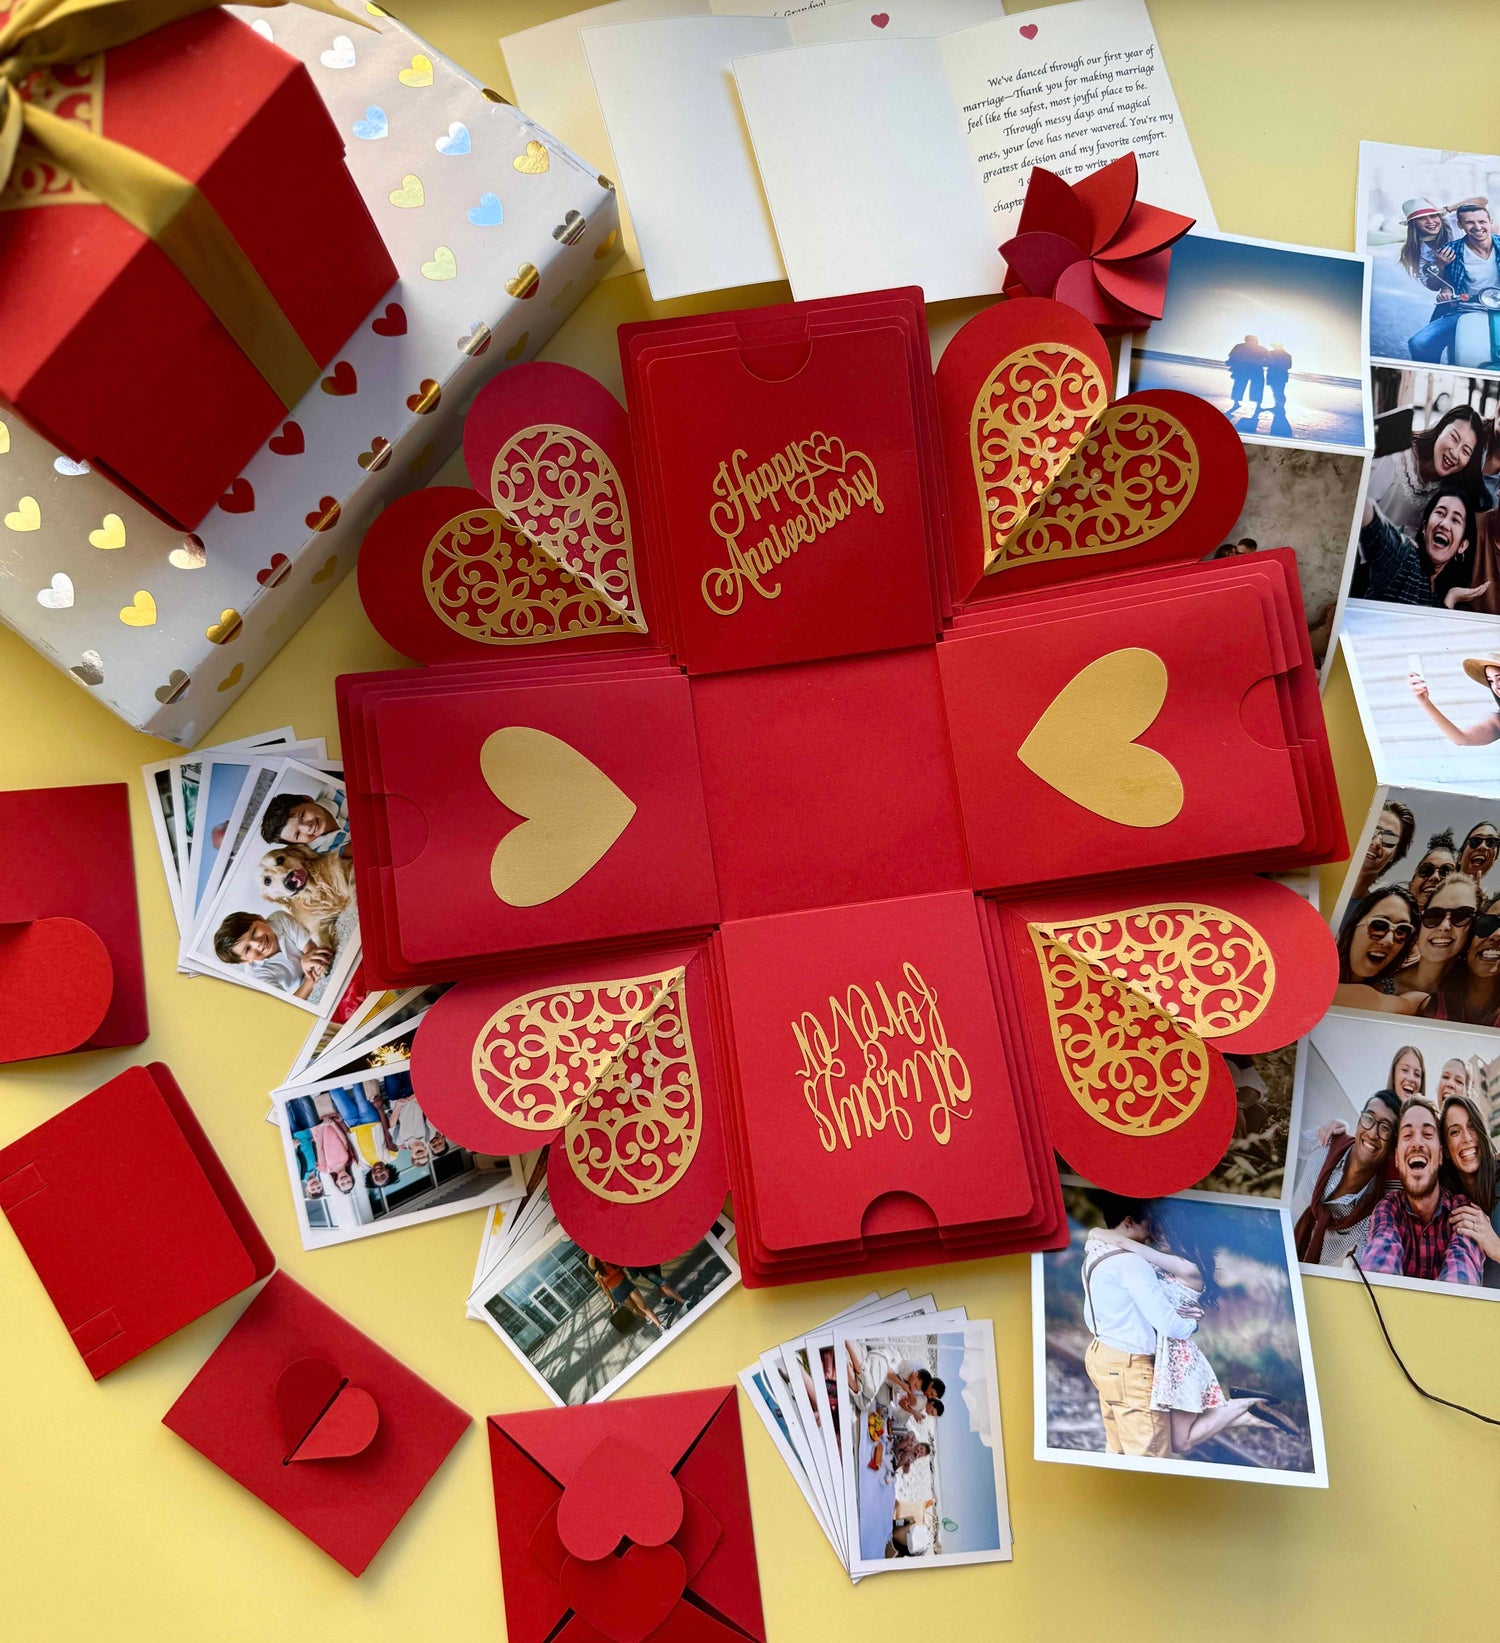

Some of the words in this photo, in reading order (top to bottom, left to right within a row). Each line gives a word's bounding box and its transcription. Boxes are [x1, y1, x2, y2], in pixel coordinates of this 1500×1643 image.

[988, 75, 1012, 86] We've
[1016, 63, 1047, 80] danced
[1050, 56, 1084, 72] through
[1087, 56, 1101, 65] our
[1104, 51, 1122, 66] first
[1124, 49, 1143, 62] year
[1146, 44, 1154, 58] of
[1046, 82, 1062, 95] you
[1064, 76, 1077, 91] for
[1080, 70, 1114, 84] making
[1116, 64, 1154, 76] marriage
[968, 115, 983, 134] feel
[985, 112, 1001, 124] like
[1004, 107, 1017, 120] the
[1020, 102, 1048, 117] safest,
[1050, 97, 1070, 108] most
[1073, 88, 1098, 107] joyful
[1101, 86, 1122, 101] place
[1136, 80, 1148, 90] be.
[1003, 118, 1042, 136] Through
[1045, 114, 1072, 126] messy
[1074, 108, 1094, 122] days
[1097, 102, 1114, 115] and
[1116, 96, 1150, 113] magical
[978, 152, 1000, 162] ones,
[1002, 144, 1024, 160] your
[1026, 138, 1044, 149] love
[1046, 133, 1062, 144] has
[1064, 128, 1088, 140] never
[1090, 118, 1128, 132] wavered.
[1130, 116, 1158, 126] You're
[1160, 114, 1174, 124] my
[983, 163, 1018, 184] greatest
[1021, 153, 1056, 168] decision
[1059, 144, 1077, 158] and
[1079, 145, 1094, 156] my
[1096, 137, 1130, 155] favorite
[1132, 130, 1167, 144] comfort.
[1075, 164, 1084, 172] to
[1086, 159, 1108, 170] write
[1138, 150, 1160, 159] more
[710, 441, 828, 539] Happy
[701, 450, 885, 616] Anniversary
[791, 962, 948, 1077] forever
[864, 1039, 889, 1086] &
[804, 1048, 972, 1152] always
